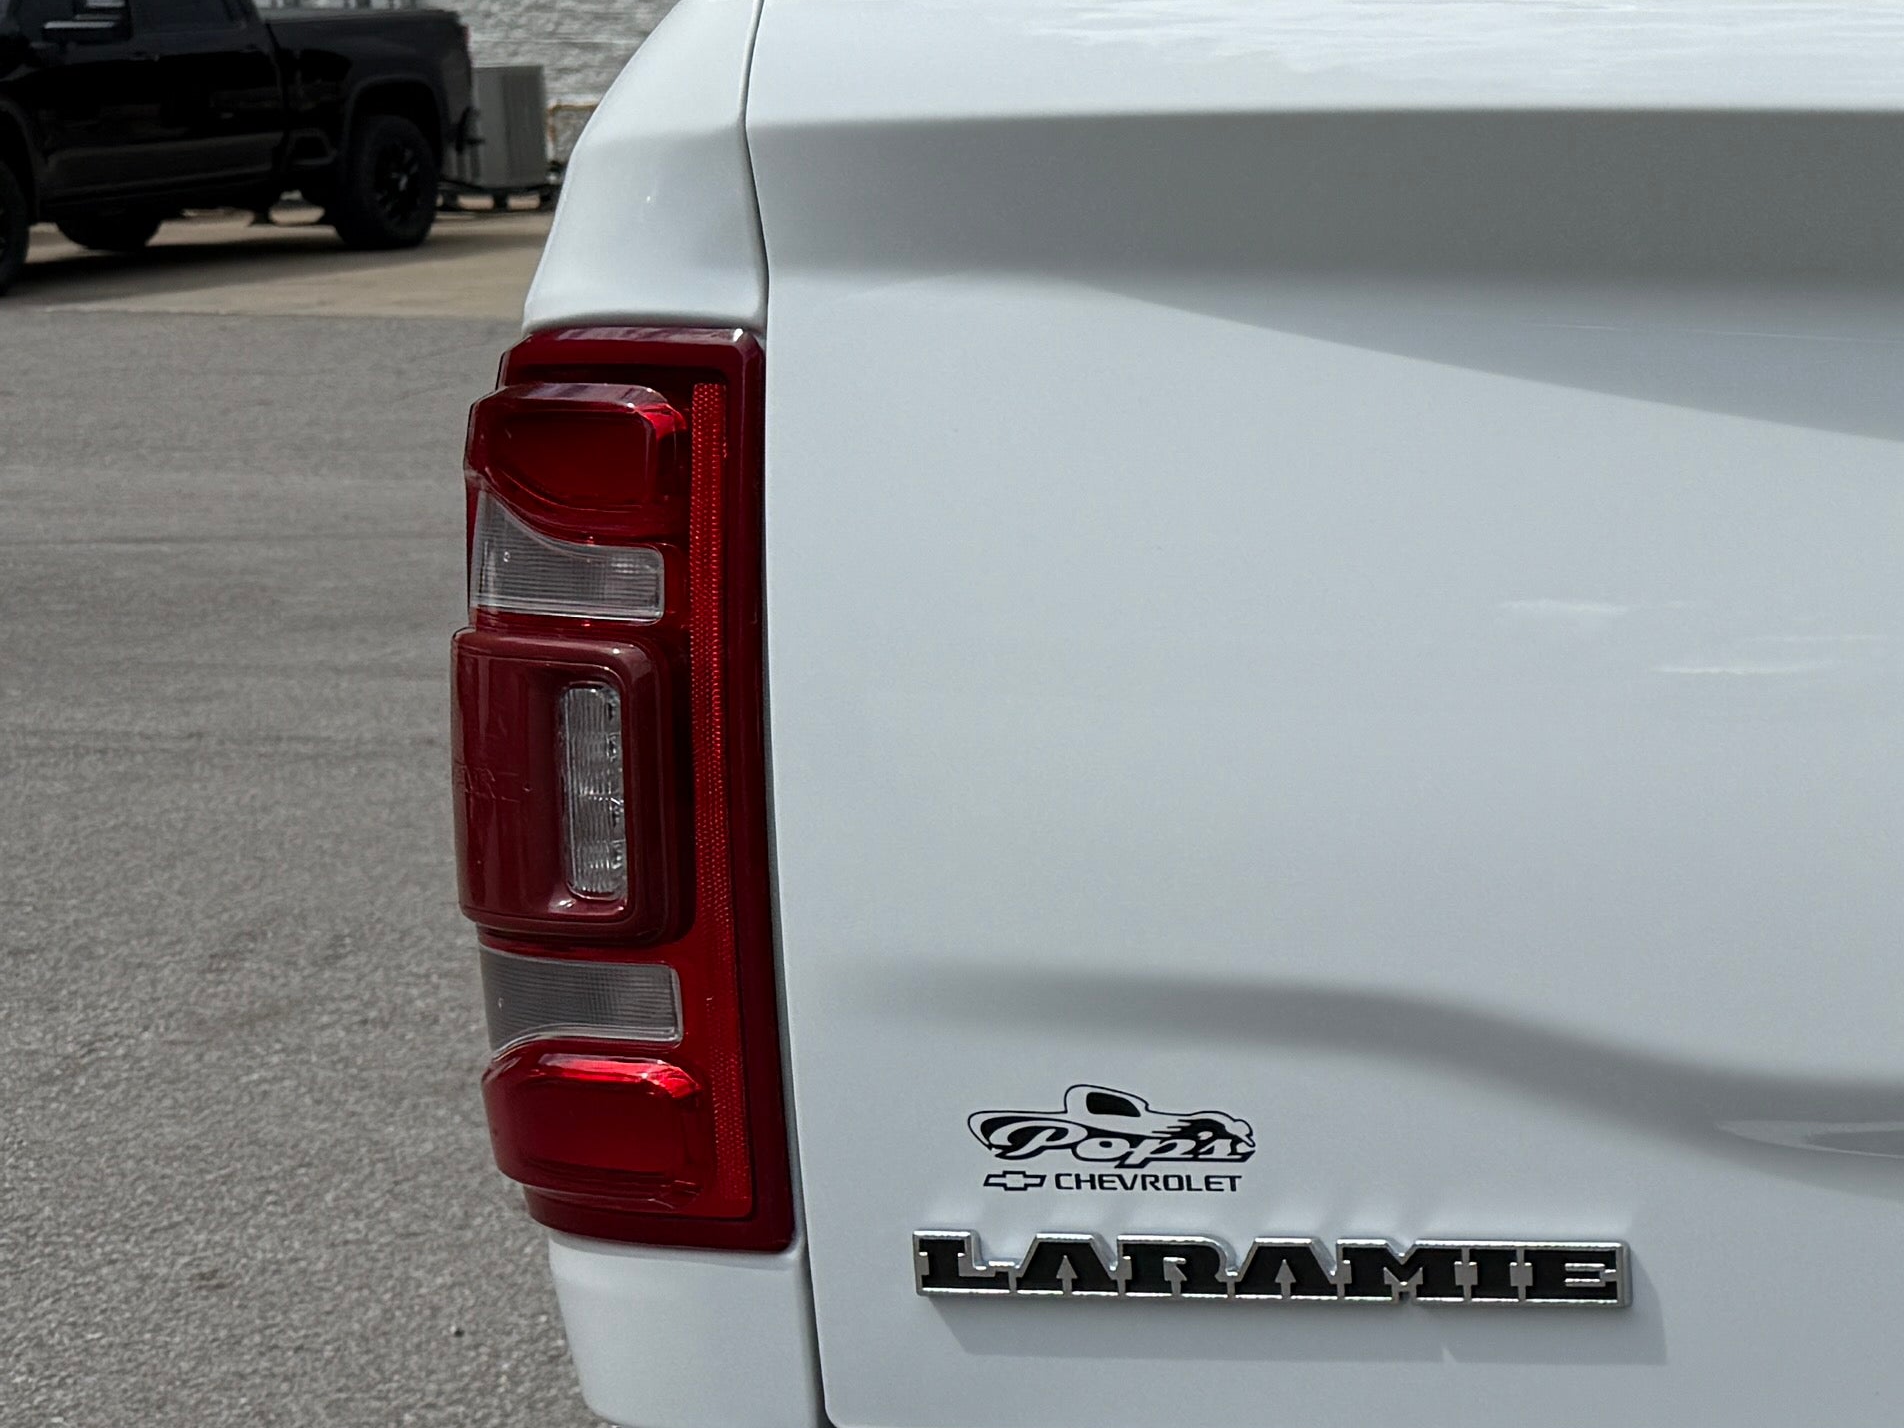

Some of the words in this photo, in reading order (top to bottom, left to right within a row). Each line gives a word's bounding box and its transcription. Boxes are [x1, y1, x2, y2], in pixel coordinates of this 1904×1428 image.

[988, 1121, 1248, 1168] Pop's
[1054, 1172, 1243, 1193] CHEVROLET
[913, 1229, 1630, 1307] LARAMIE
